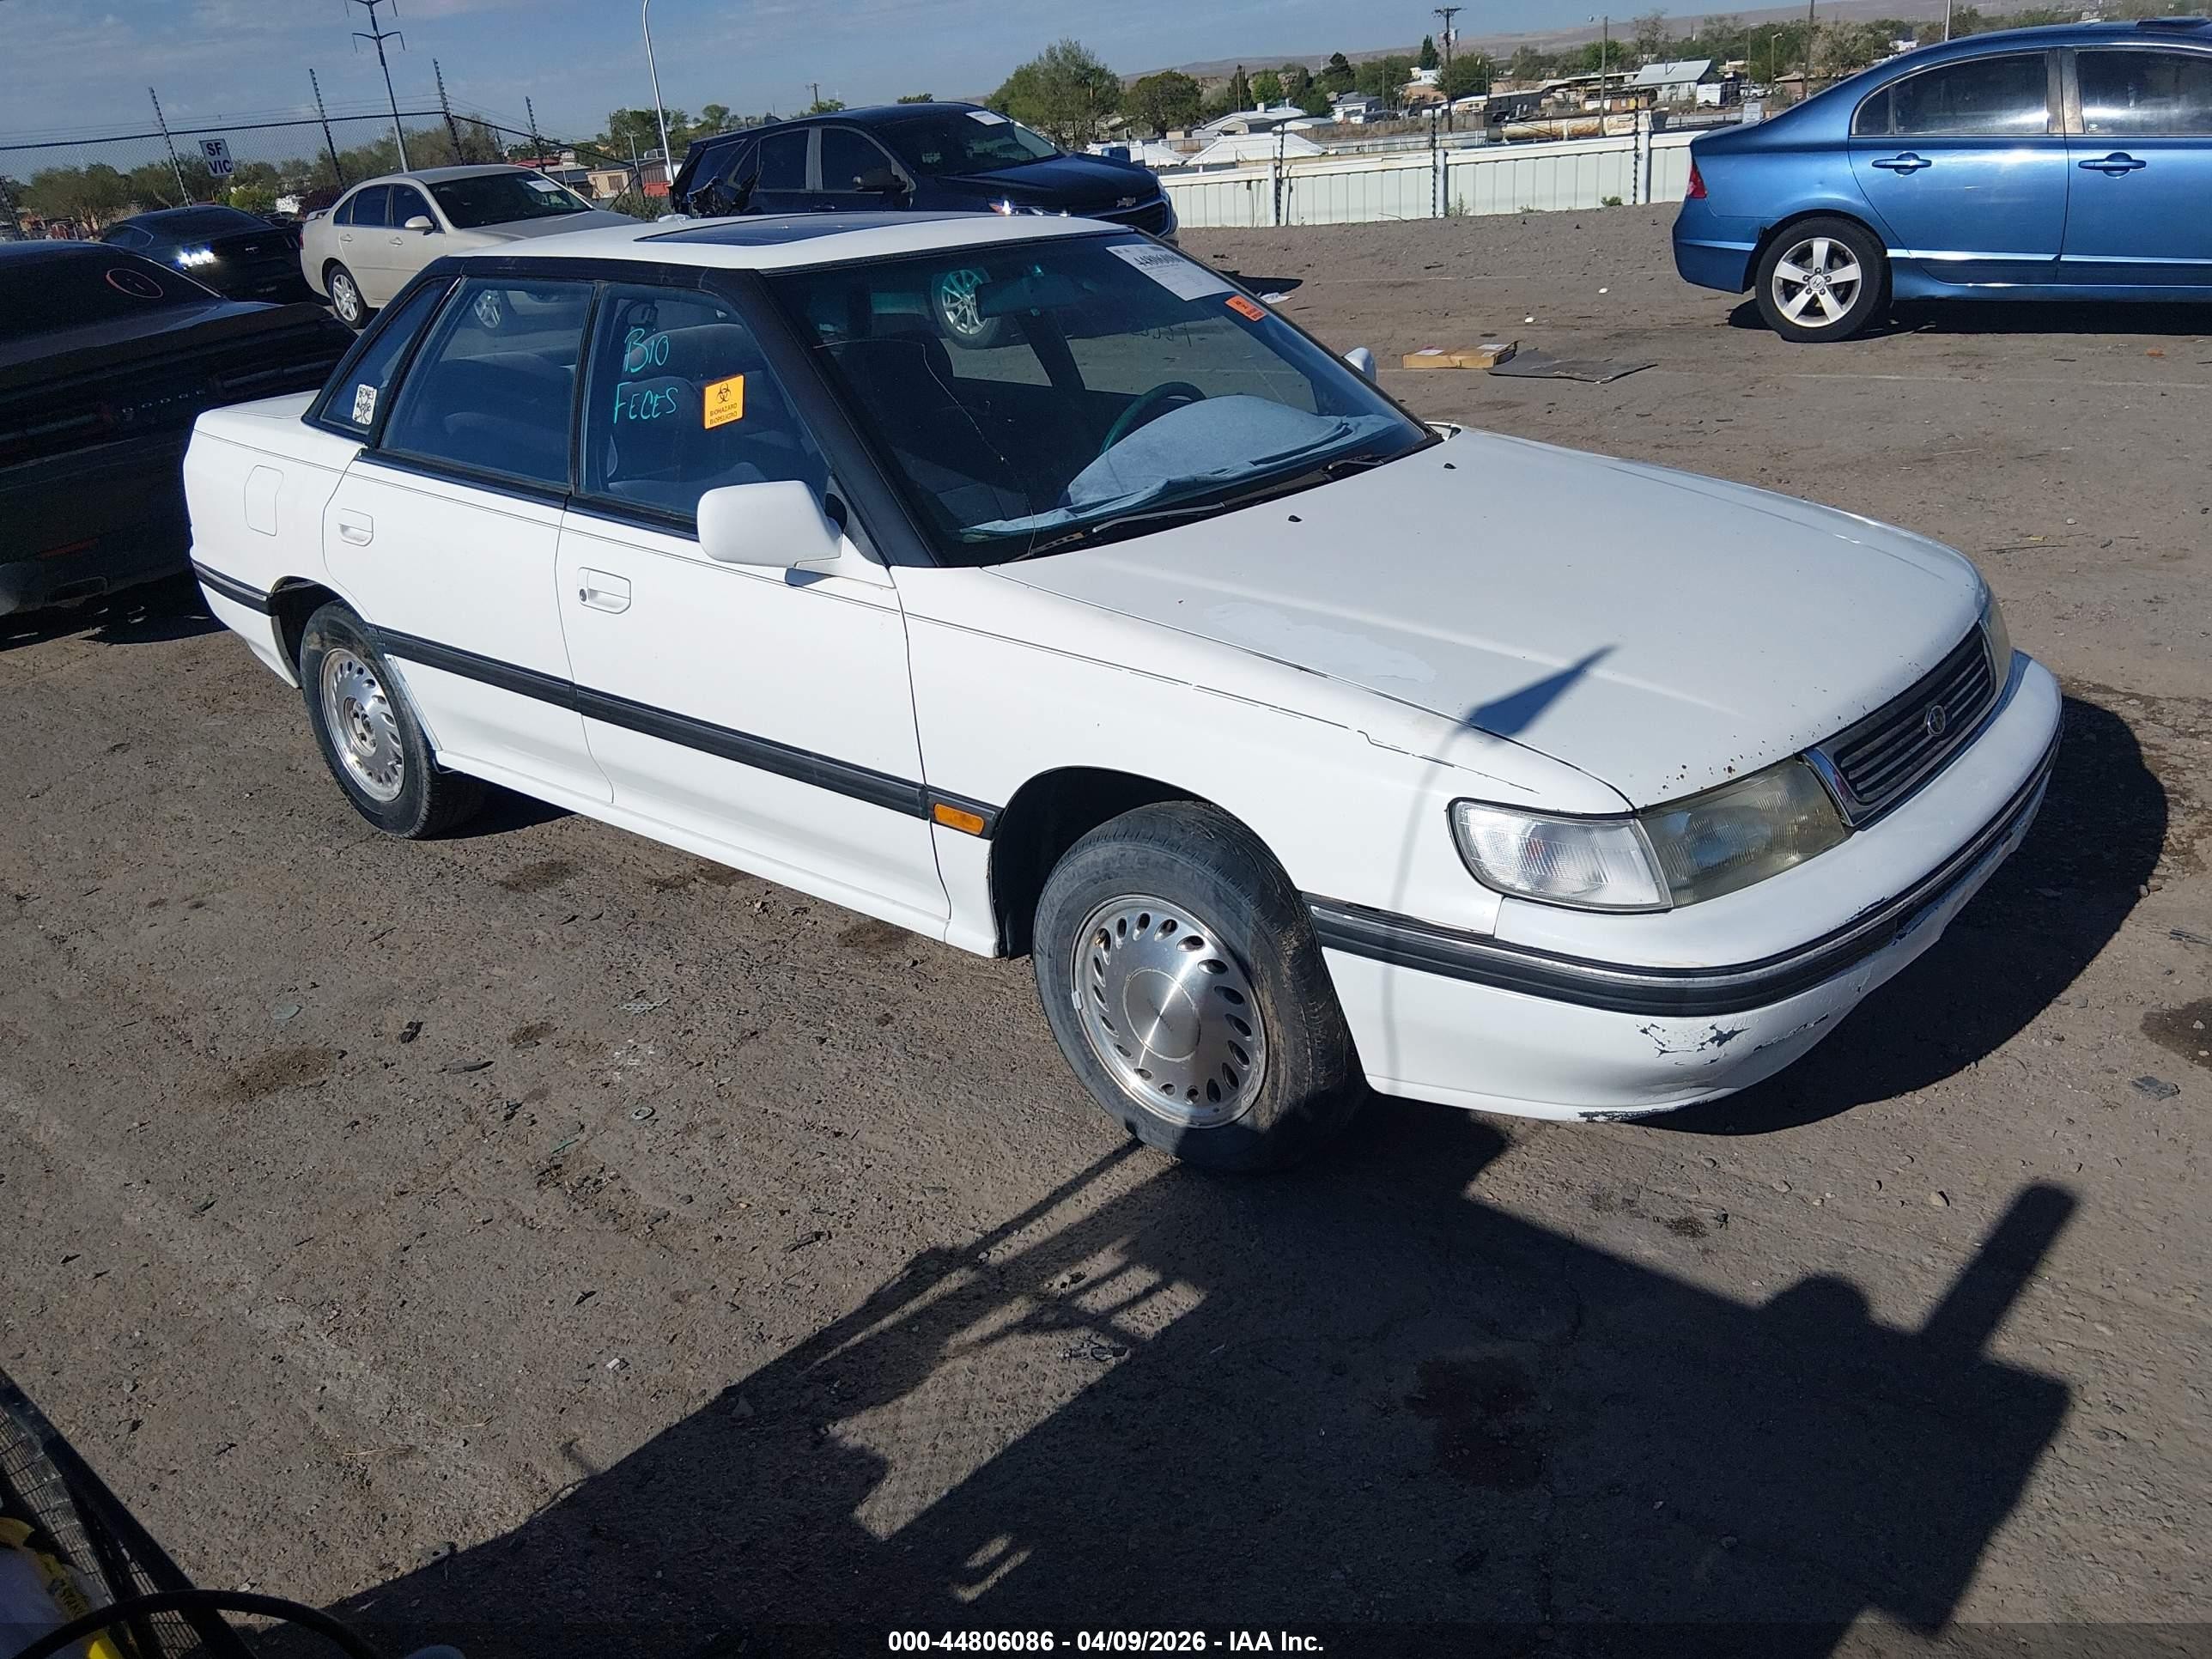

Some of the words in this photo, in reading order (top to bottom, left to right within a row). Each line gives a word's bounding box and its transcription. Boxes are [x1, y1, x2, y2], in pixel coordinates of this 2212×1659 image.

[206, 142, 222, 156] SF
[208, 160, 232, 174] VIC
[613, 381, 678, 424] FECES
